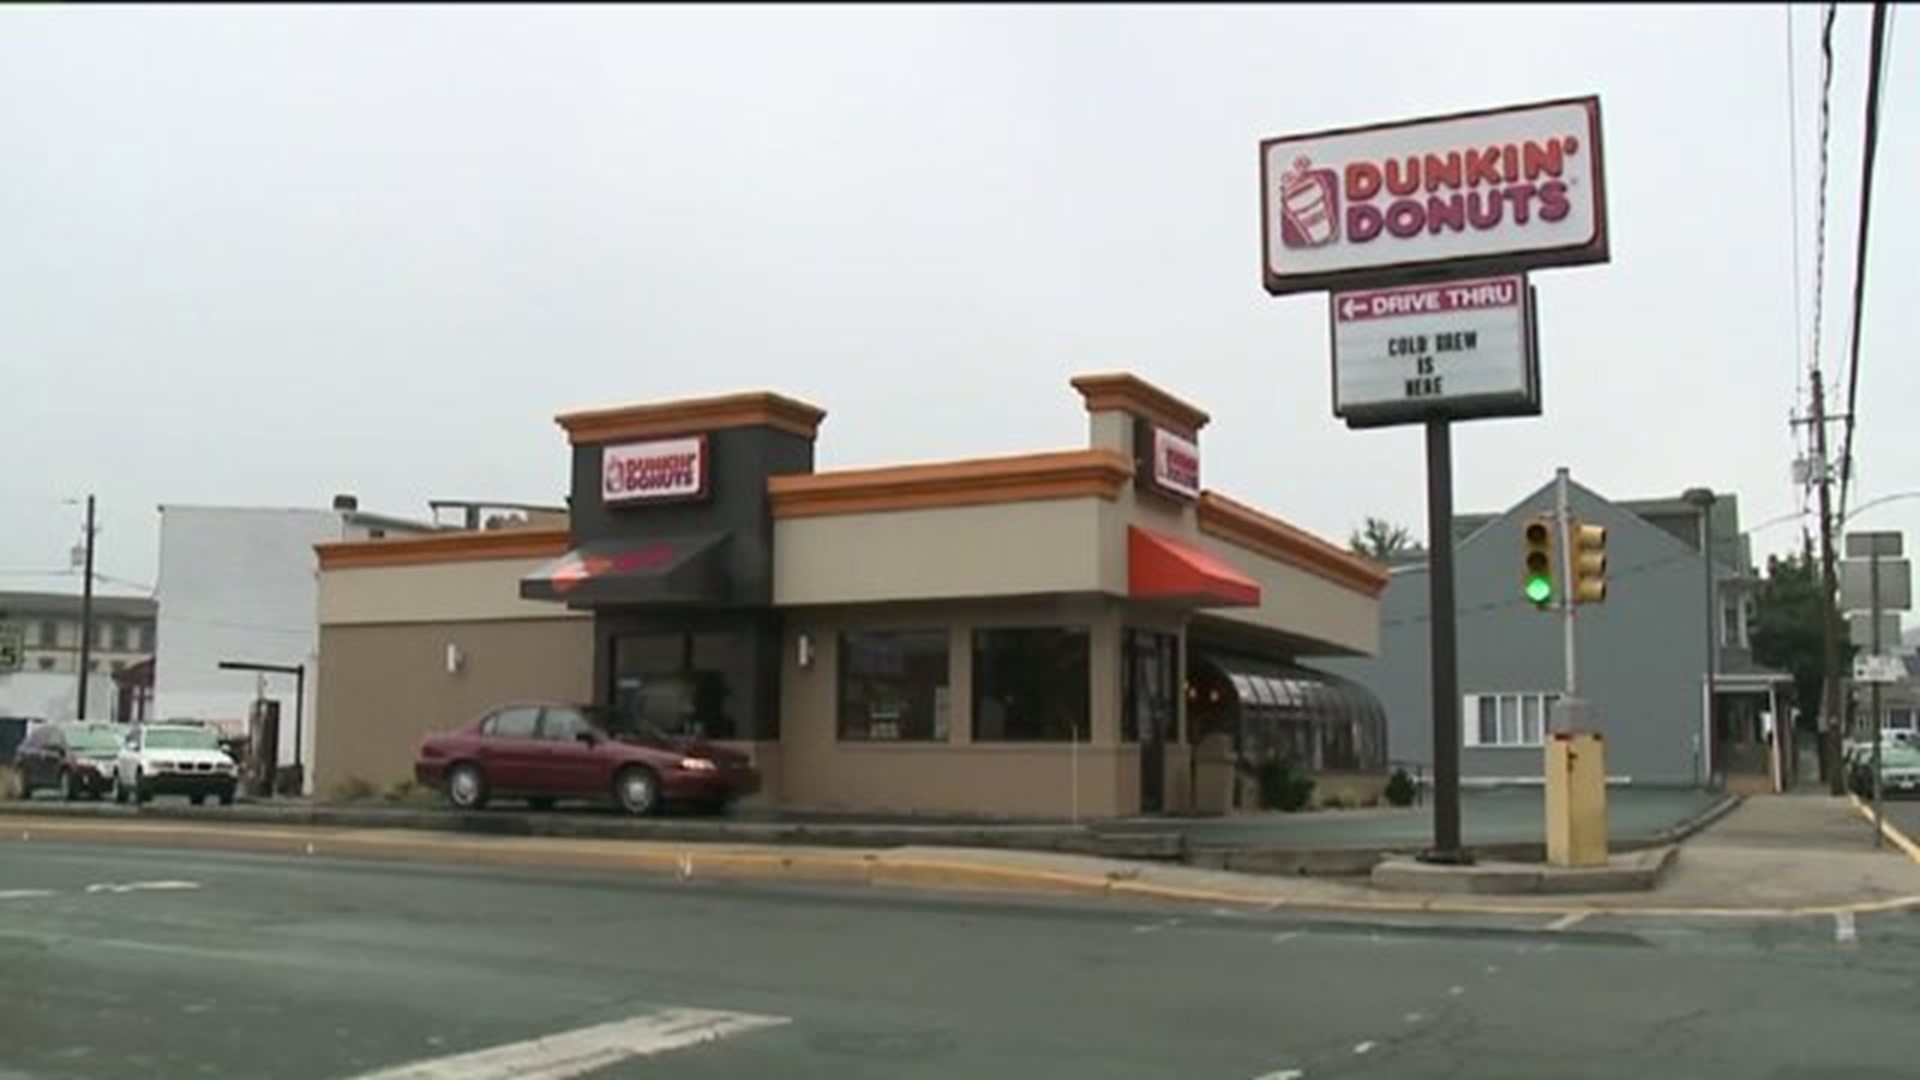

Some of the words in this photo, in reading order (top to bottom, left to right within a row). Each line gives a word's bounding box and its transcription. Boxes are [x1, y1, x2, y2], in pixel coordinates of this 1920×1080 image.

[1345, 136, 1578, 201] DUNKIN'
[1347, 182, 1571, 242] DONUTS
[1372, 293, 1440, 316] DRIVE
[1447, 284, 1513, 307] THRU
[1388, 335, 1428, 356] COLD
[1436, 332, 1477, 352] BREW
[1418, 357, 1434, 374] IS
